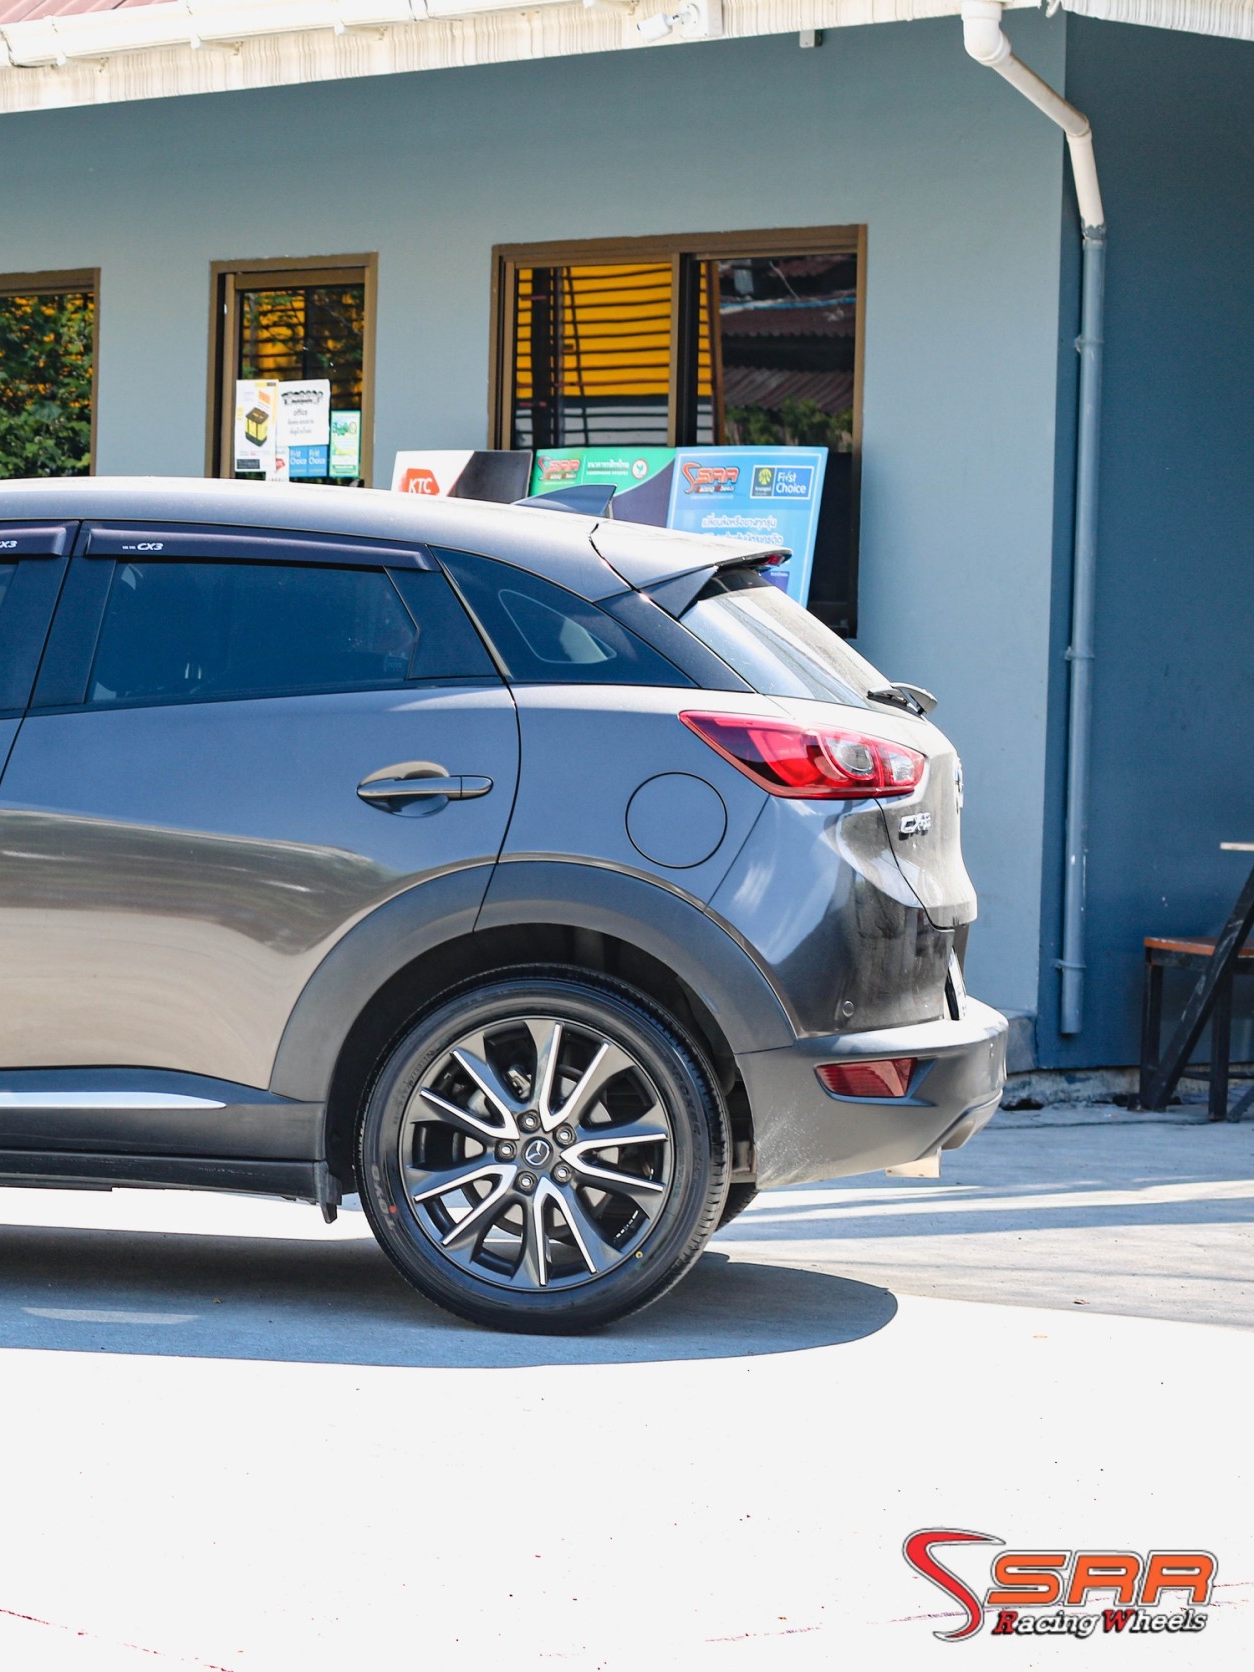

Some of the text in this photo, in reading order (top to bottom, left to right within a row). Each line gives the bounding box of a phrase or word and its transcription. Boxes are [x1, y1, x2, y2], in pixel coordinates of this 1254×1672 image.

[777, 471, 797, 483] First
[408, 477, 433, 494] KTC
[775, 482, 807, 494] Choice
[137, 542, 164, 551] CX3
